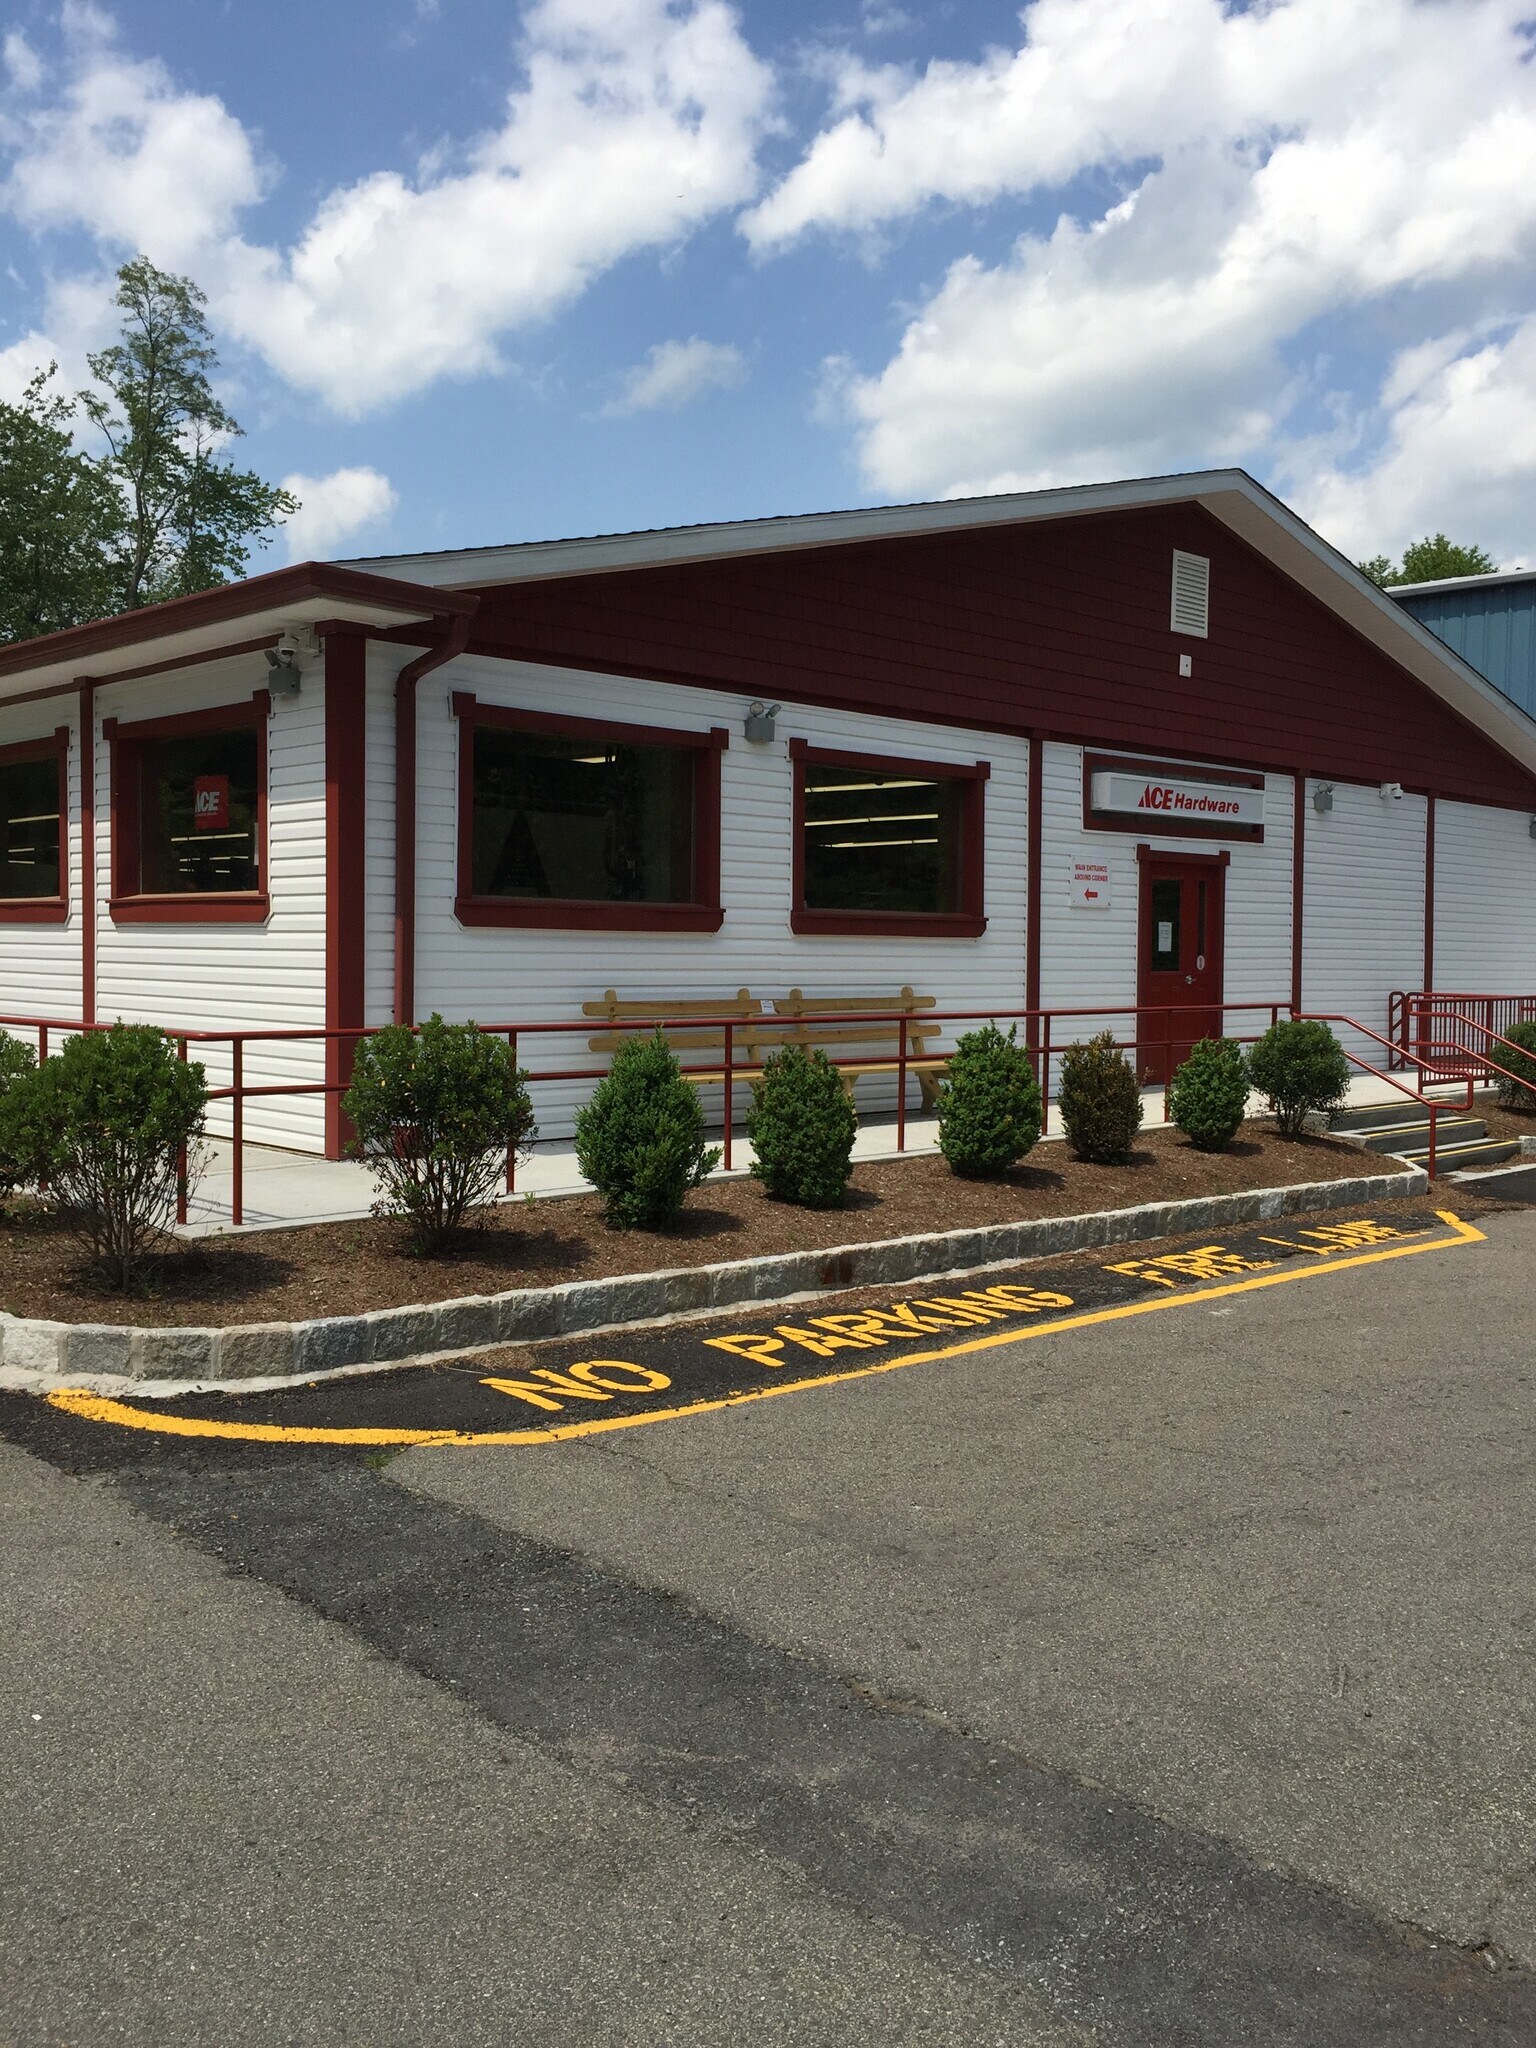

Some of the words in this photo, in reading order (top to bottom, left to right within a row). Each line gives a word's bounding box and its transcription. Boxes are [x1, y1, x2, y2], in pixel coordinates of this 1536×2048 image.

[195, 790, 220, 813] ACE
[1138, 783, 1174, 810] ACE
[1174, 793, 1240, 814] Hardware
[1092, 874, 1109, 882] CORNER
[479, 1360, 672, 1411] NO
[702, 1285, 1075, 1367] PARKING
[1101, 1245, 1282, 1288] FIRE
[1257, 1219, 1433, 1256] LANE
